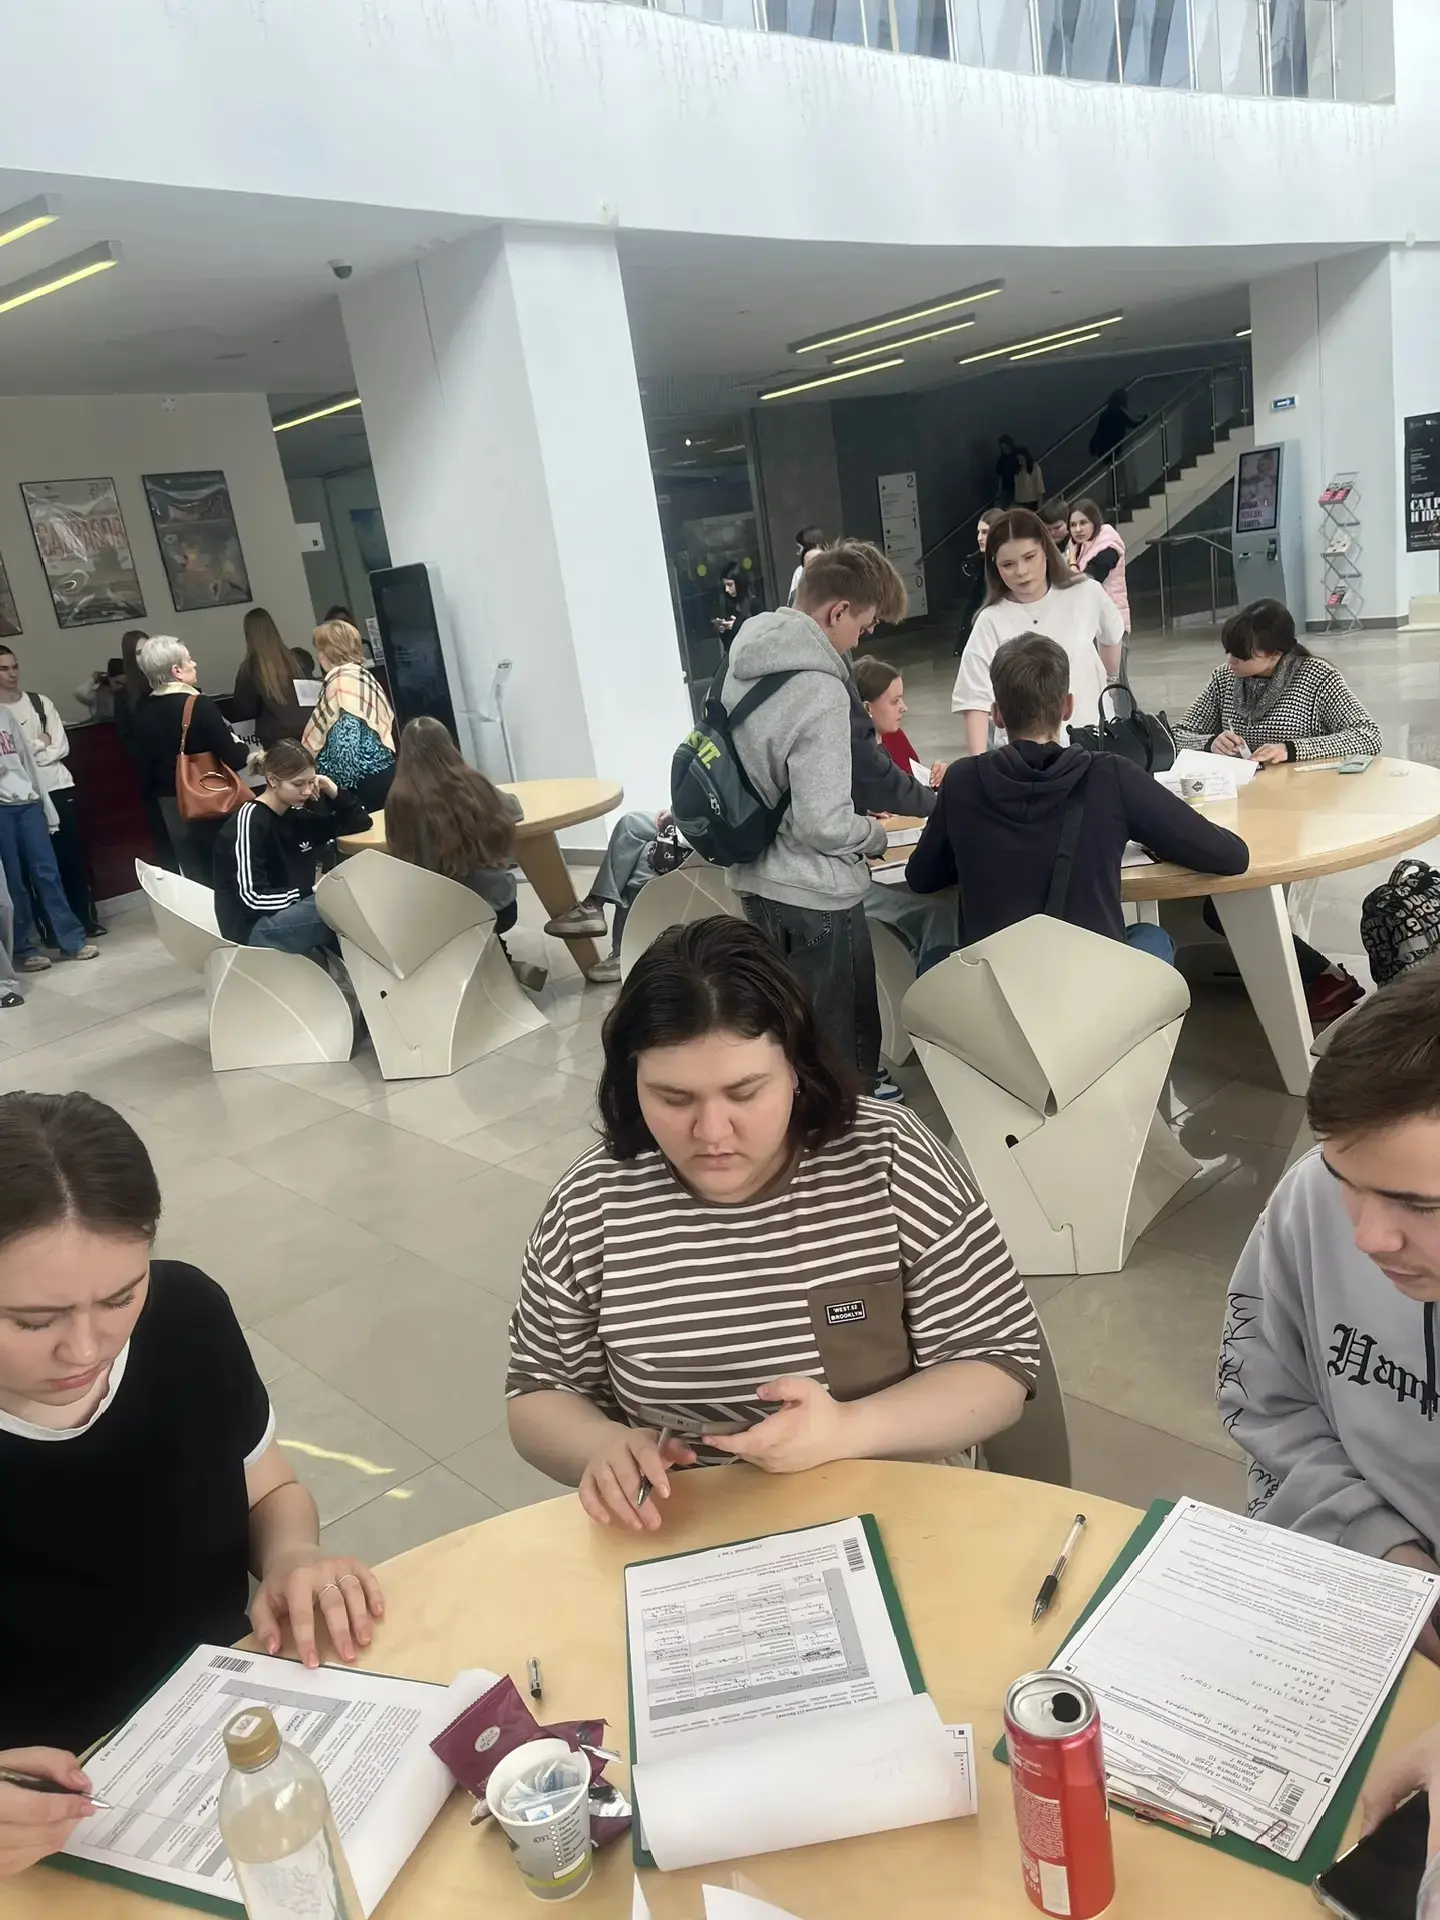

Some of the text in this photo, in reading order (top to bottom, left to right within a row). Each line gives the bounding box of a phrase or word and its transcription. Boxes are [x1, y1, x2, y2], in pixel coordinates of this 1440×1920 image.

[906, 475, 914, 488] 2
[911, 517, 917, 529] 1
[915, 575, 923, 587] 0
[833, 1305, 850, 1313] WEST
[830, 1311, 862, 1321] BROOKLYN
[1239, 1775, 1256, 1786] Код
